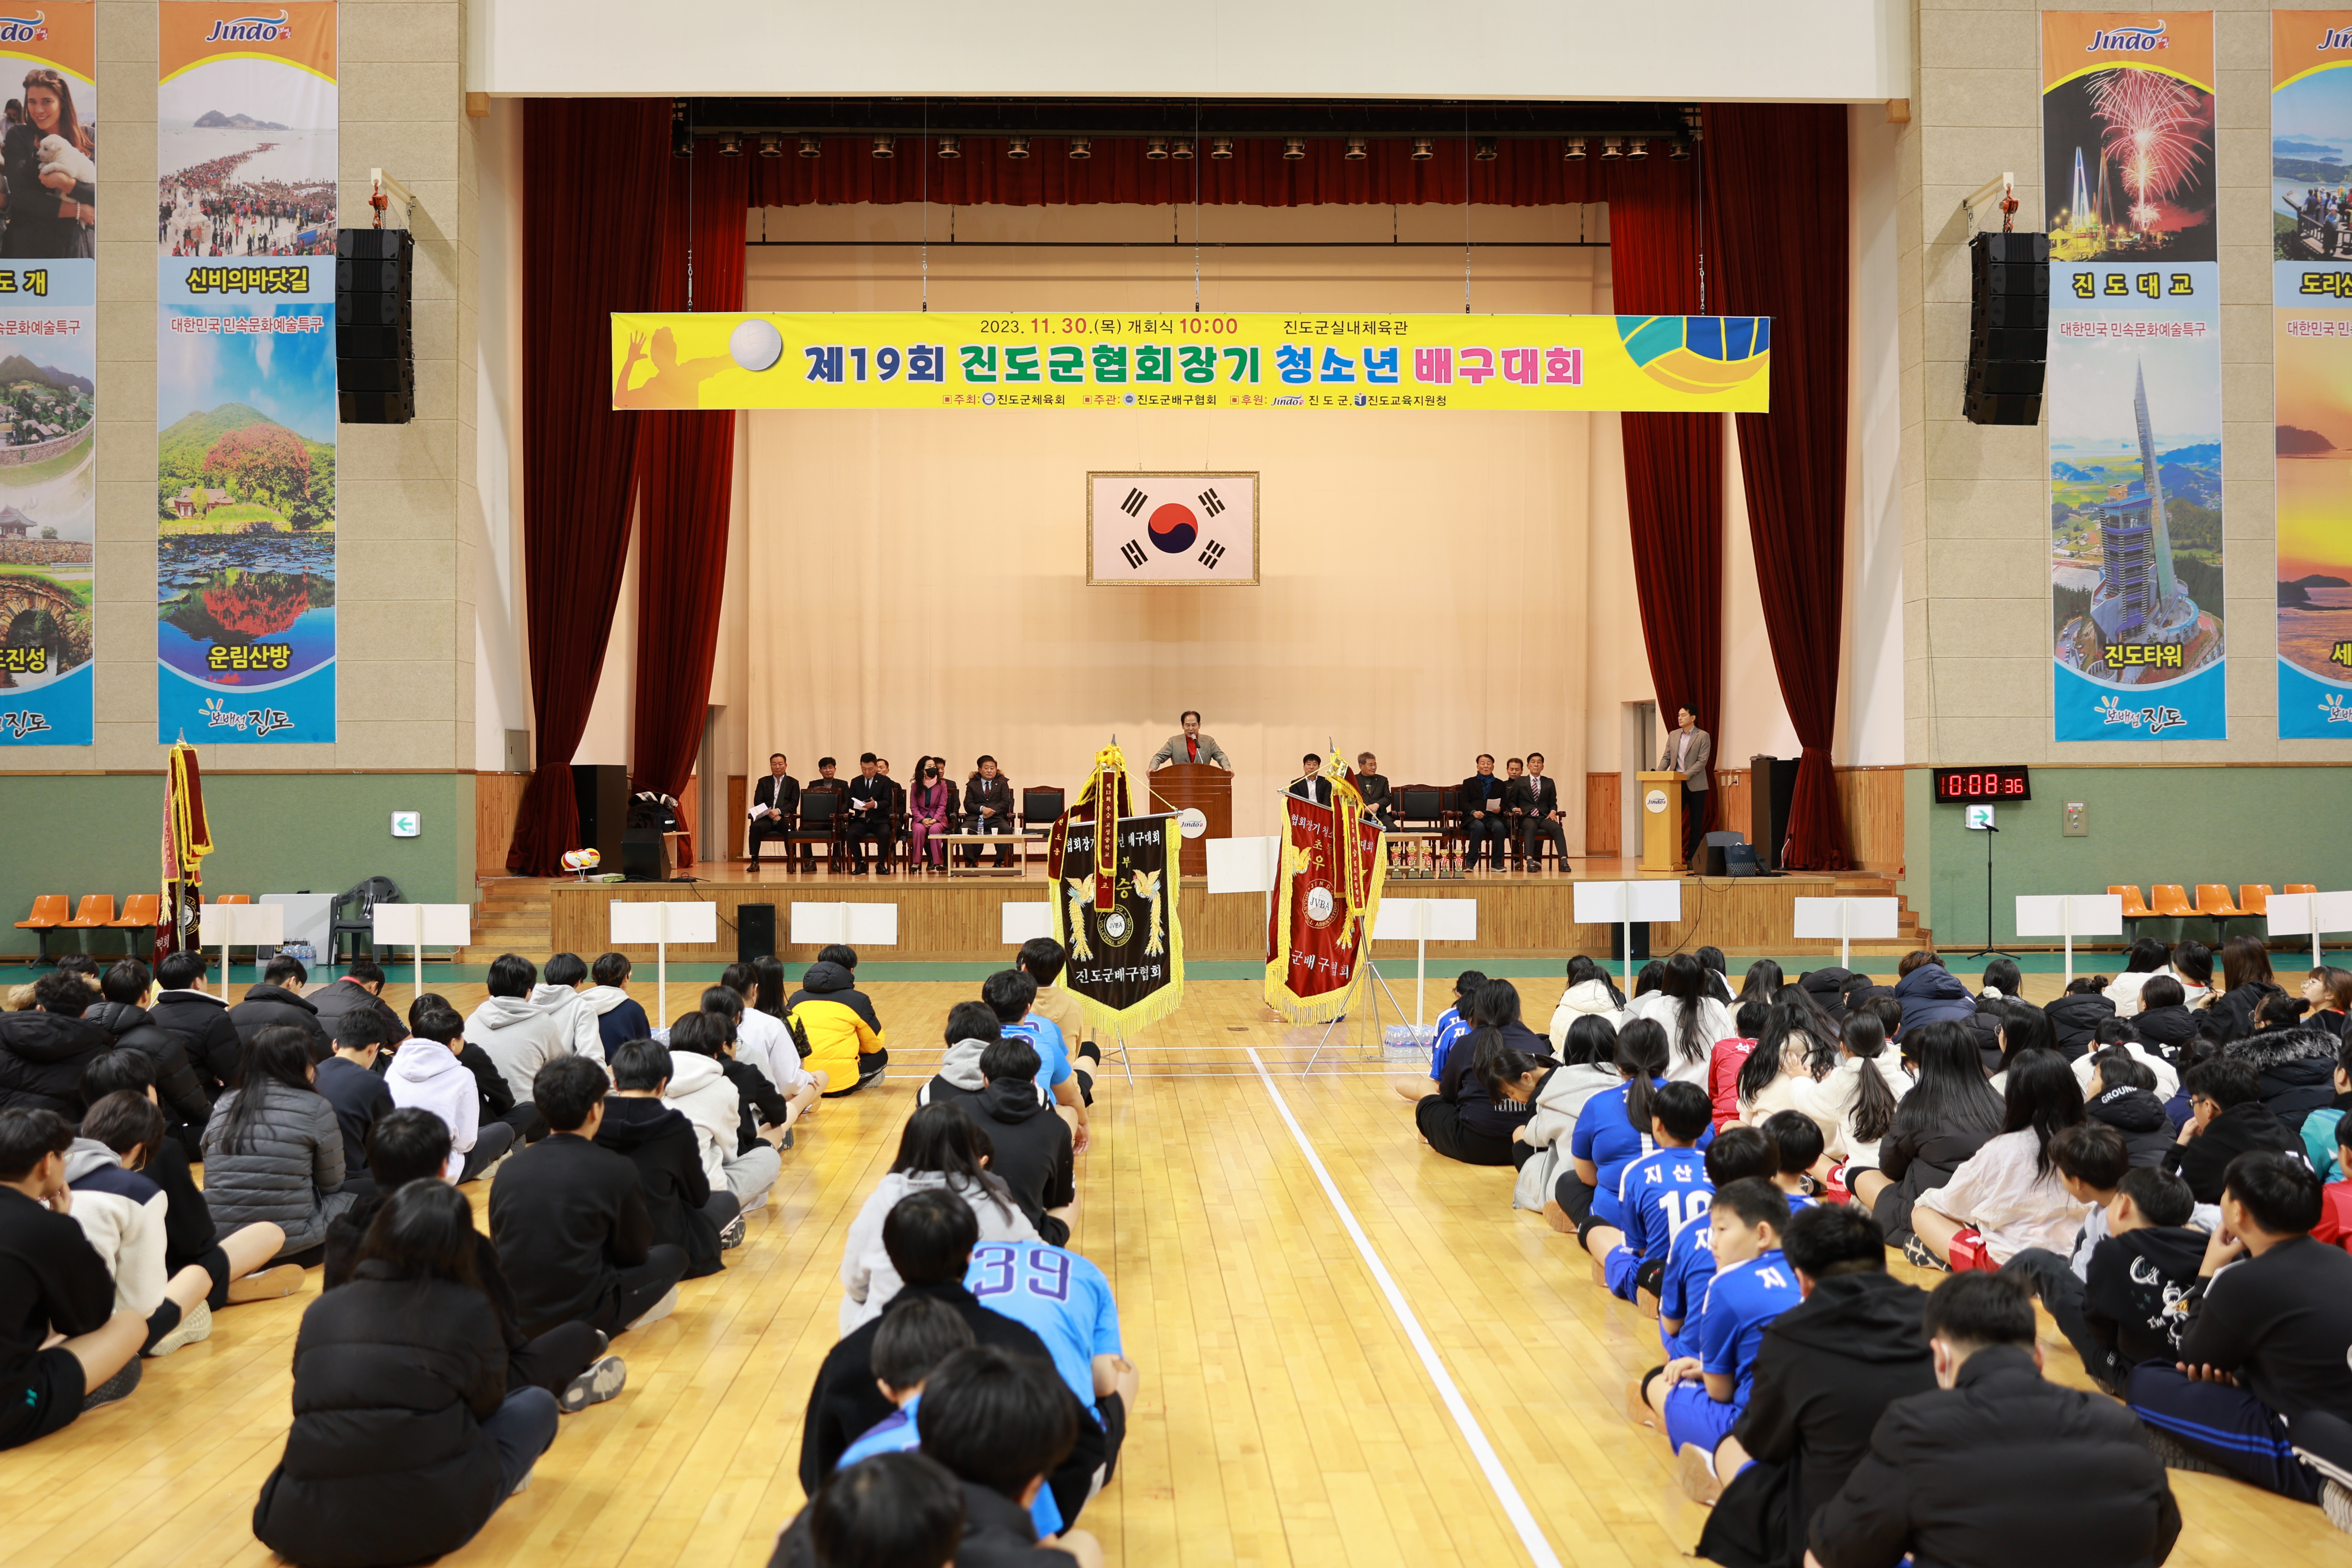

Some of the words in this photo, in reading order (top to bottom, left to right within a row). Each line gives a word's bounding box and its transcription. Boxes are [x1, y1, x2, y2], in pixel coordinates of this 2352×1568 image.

[206, 20, 278, 41] Jindo
[2086, 30, 2157, 51] Jindo
[187, 267, 308, 292] 신비의바닷길
[172, 317, 220, 333] 대한민국
[224, 317, 323, 333] 민속문화예술특구
[981, 320, 1023, 334] 2023.
[1031, 318, 1055, 334] 11.
[1128, 320, 1172, 334] 개회식
[1180, 318, 1238, 334] 10:00
[1284, 320, 1408, 335] 진도군실내체육관
[2060, 322, 2108, 337] 대한민국
[2111, 322, 2206, 337] 민속문화예술특구
[2288, 321, 2334, 336] 대한민국
[2338, 321, 2352, 336] 민
[805, 344, 944, 383] 제19회
[960, 344, 1259, 383] 진도군협회장기
[1275, 345, 1399, 383] 청소년
[1414, 347, 1581, 384] 배구대회
[997, 394, 1065, 405] 진도군체육회
[1137, 394, 1216, 405] 진도군배구협회
[1271, 397, 1298, 406] Jindo
[1368, 395, 1446, 406] 진도교육지원청
[207, 644, 291, 669] 운림산방
[2104, 643, 2183, 668] 진도타워
[4, 711, 51, 738] 진도
[209, 711, 246, 731] 보배섬
[248, 708, 294, 736] 진도
[2104, 708, 2141, 728] 보배섬
[2142, 705, 2187, 733] 진도
[1105, 806, 1111, 818] 우승
[1291, 814, 1320, 835] 협회장기
[1128, 829, 1160, 847] 배구대회
[1351, 837, 1357, 857] 우승
[1310, 897, 1329, 911] JVBA
[1315, 902, 1337, 927] ASSOCIATION
[1098, 920, 1115, 945] VOLLEYBALL
[1117, 918, 1132, 945] ASSOCIATION
[1075, 964, 1161, 984] 진도군배구협회
[1291, 950, 1349, 979] 군배구협회
[2101, 1085, 2137, 1104] GROUND
[973, 1246, 1071, 1302] 39
